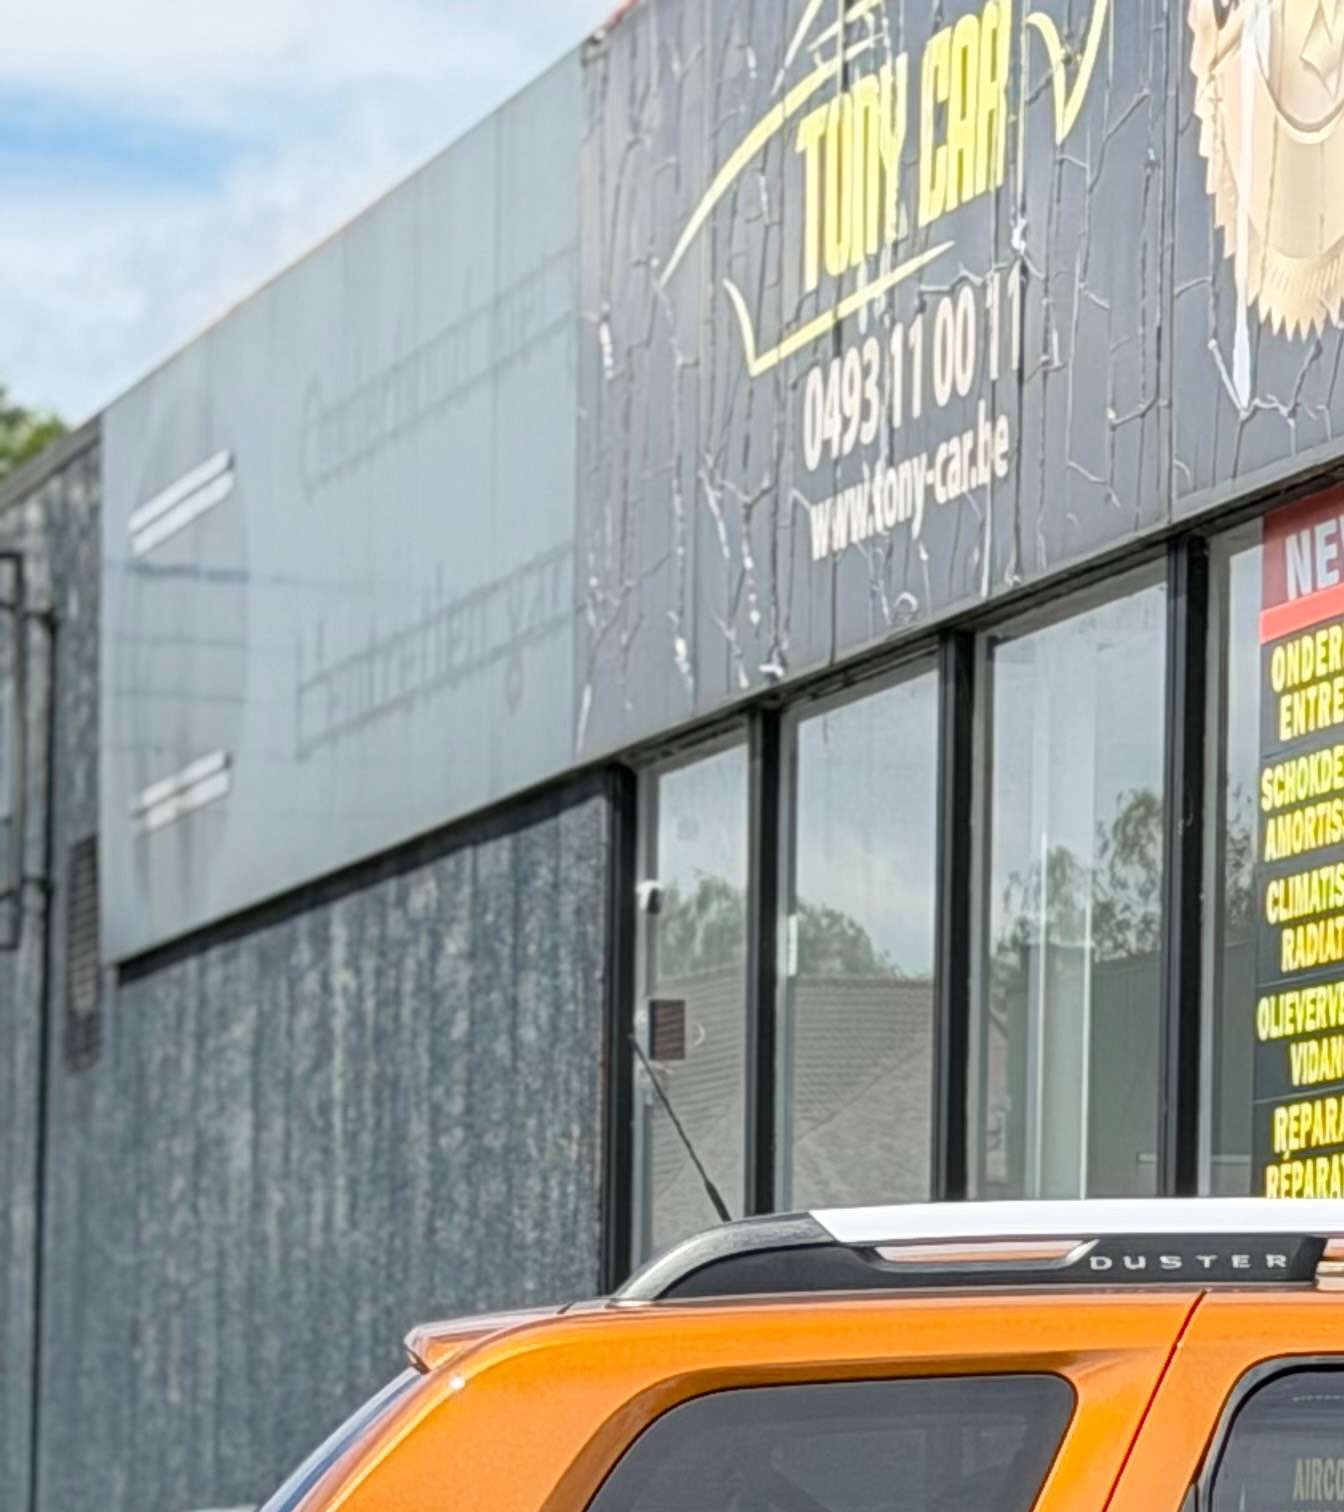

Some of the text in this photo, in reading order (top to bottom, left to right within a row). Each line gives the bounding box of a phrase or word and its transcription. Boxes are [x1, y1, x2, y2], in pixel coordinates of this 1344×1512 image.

[796, 0, 1011, 293] TONY CAR
[803, 337, 880, 471] 0493
[889, 313, 924, 428] 11
[933, 286, 976, 407] 00
[810, 398, 1010, 560] www.tony-car.be
[1090, 1254, 1288, 1271] DUSTER
